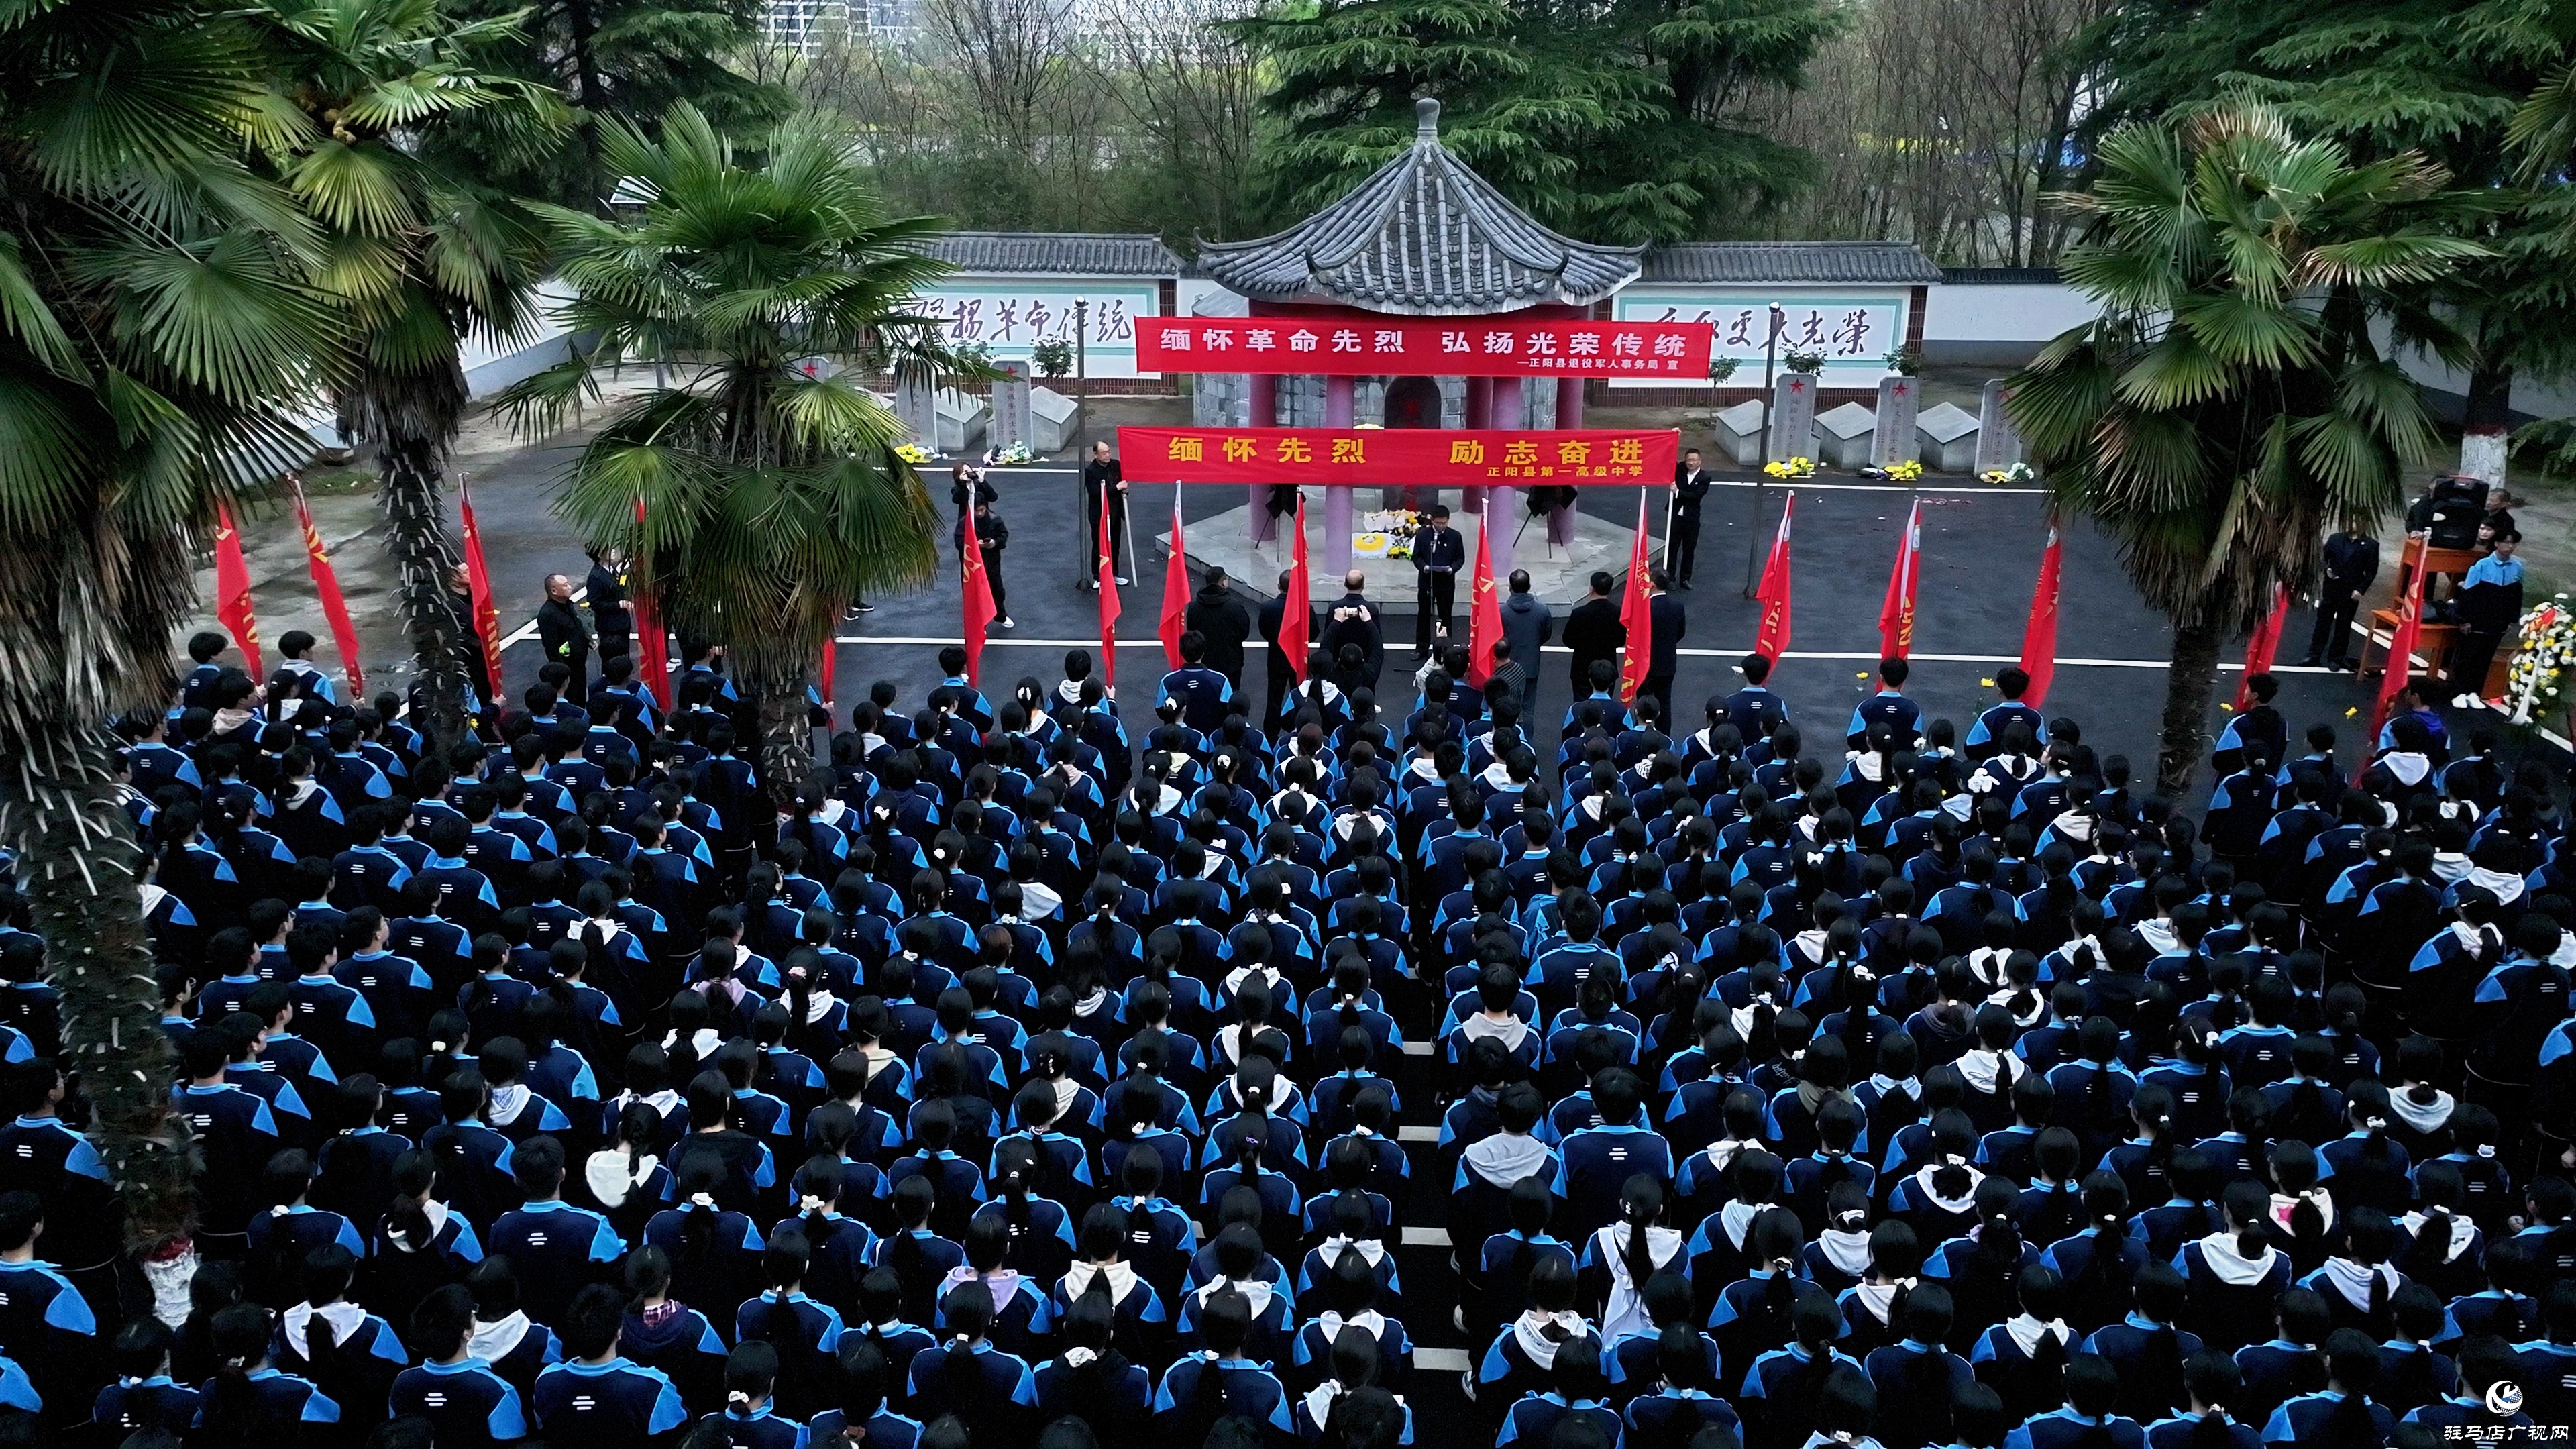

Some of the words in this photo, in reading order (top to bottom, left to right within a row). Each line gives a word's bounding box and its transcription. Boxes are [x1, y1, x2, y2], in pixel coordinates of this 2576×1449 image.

[1160, 328, 1405, 354] 缅怀革命先烈
[1442, 331, 1686, 358] 弘扬光荣传统
[1666, 360, 1679, 370] 宣
[1168, 437, 1366, 464] 缅怀先烈
[1449, 439, 1644, 466] 励志奋进
[1487, 466, 1644, 478] 正阳县第一高级中学
